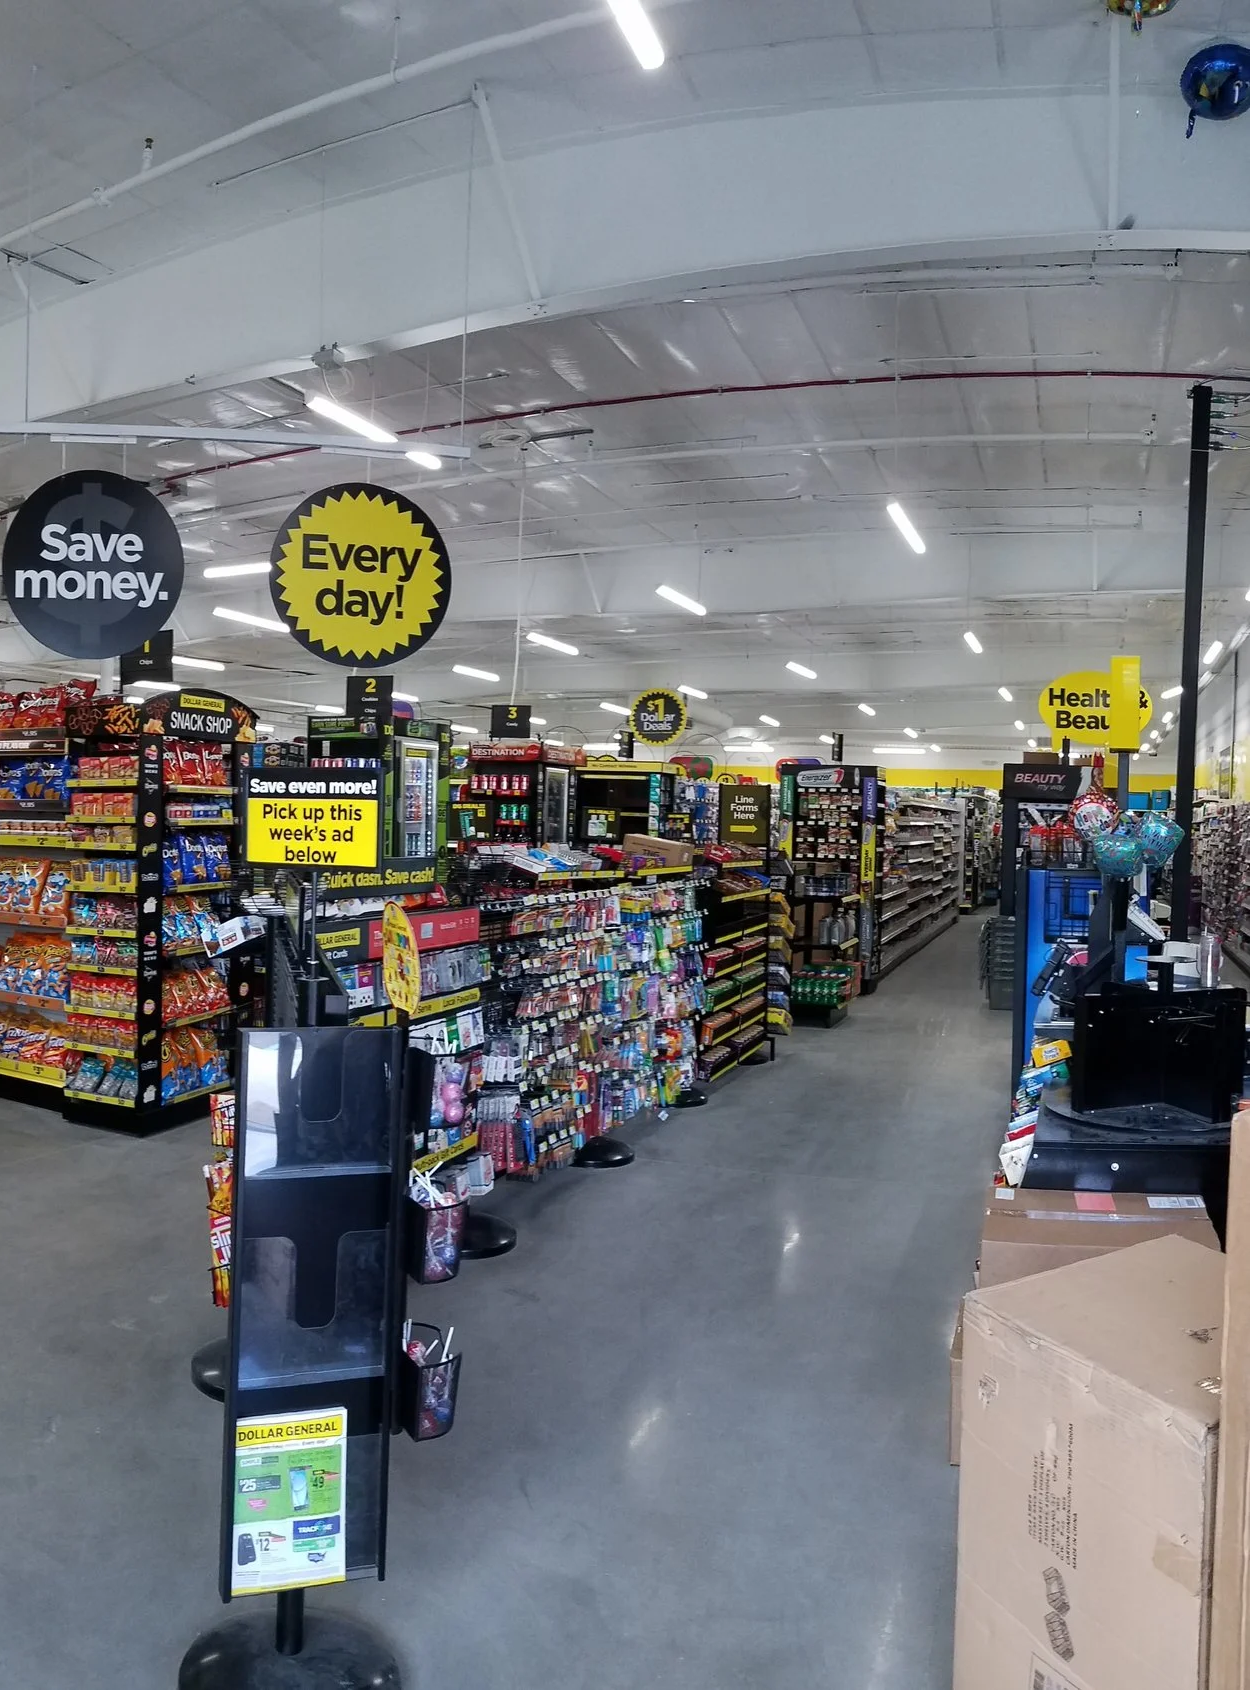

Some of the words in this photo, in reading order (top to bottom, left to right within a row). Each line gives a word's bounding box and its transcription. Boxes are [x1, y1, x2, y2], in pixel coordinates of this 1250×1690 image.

[40, 524, 144, 564] Save
[301, 534, 422, 583] Every
[14, 568, 168, 608] money.
[314, 584, 405, 626] day!
[365, 678, 377, 693] 2
[1048, 688, 1110, 708] Healt
[508, 707, 517, 719] 3
[1056, 710, 1110, 730] Beau
[170, 711, 203, 731] SNACK
[205, 714, 232, 734] SHOP
[643, 721, 672, 731] Deals
[471, 747, 525, 756] DESTINATION
[801, 771, 832, 783] Energizer
[1014, 773, 1066, 783] BEAUTY
[250, 778, 286, 794] Save
[291, 781, 326, 795] even
[328, 779, 377, 795] more!
[730, 803, 758, 812] Forms
[735, 795, 754, 804] Line
[263, 803, 297, 820] Pick
[303, 807, 324, 824] up
[330, 804, 362, 821] this
[733, 812, 755, 820] Here
[269, 825, 327, 842] week's
[332, 826, 354, 842] ad
[285, 846, 337, 864] below
[385, 870, 409, 884] Save
[410, 867, 434, 882] cash!
[238, 1427, 283, 1442] DOLLAR
[286, 1421, 338, 1436] GENERAL
[239, 1478, 257, 1492] $25
